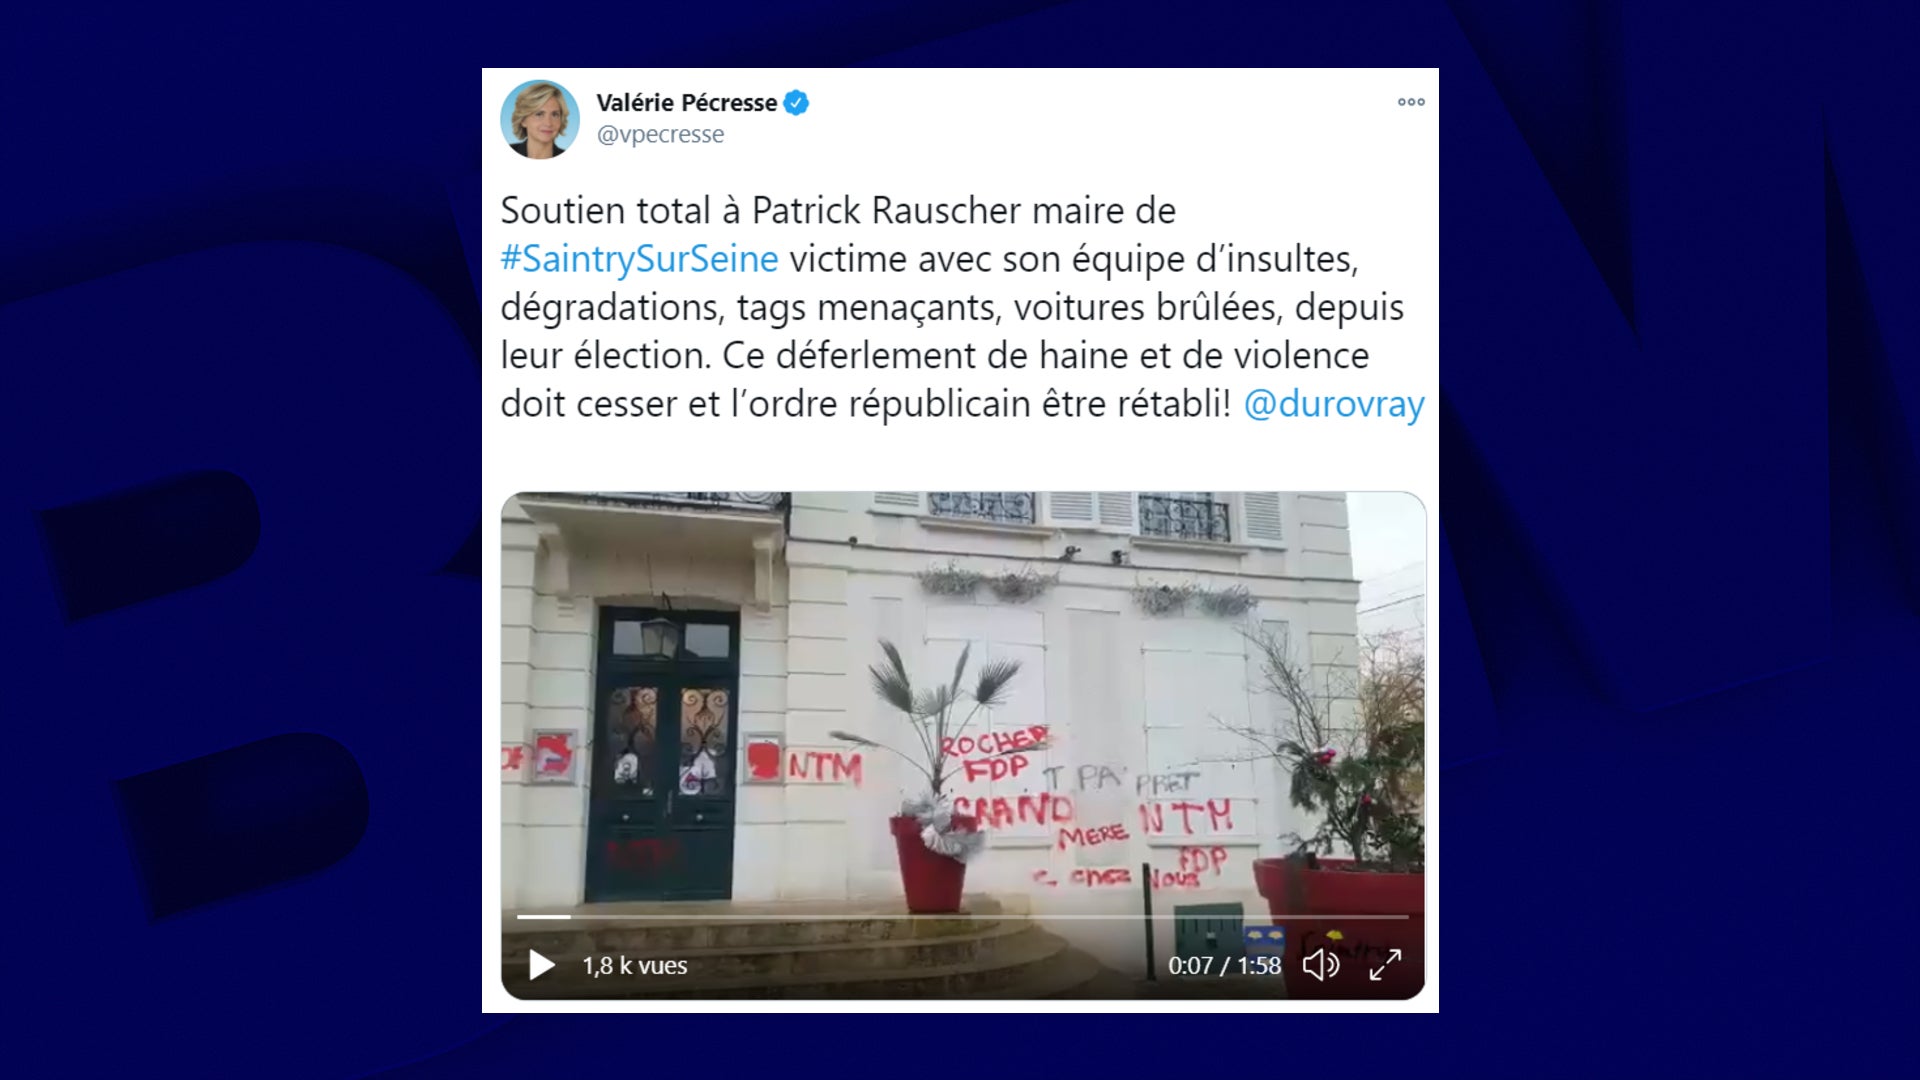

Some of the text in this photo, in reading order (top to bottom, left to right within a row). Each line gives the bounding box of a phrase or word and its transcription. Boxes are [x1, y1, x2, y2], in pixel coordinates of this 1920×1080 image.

[596, 92, 778, 112] Valérie Pécresse
[597, 125, 725, 148] @vpecresse
[502, 194, 1176, 224] Soutien total à Patrick Rauscher maire de
[501, 242, 1357, 281] #SaintrySurSeine victime avec son équipe d’insultes,
[502, 291, 1403, 329] dégradations, tags menaçants, voitures brûlées, depuis
[503, 339, 1369, 369] leur élection. Ce déferlement de haine et de violence
[502, 387, 1425, 426] doit cesser et l’ordre républicain être rétabli! @durovray
[788, 751, 863, 787] NTM
[963, 755, 1028, 783] FDP
[1139, 797, 1234, 835] NTM
[583, 956, 688, 978] 1,8 k vues
[1168, 956, 1282, 978] 0:07 / 1:58
